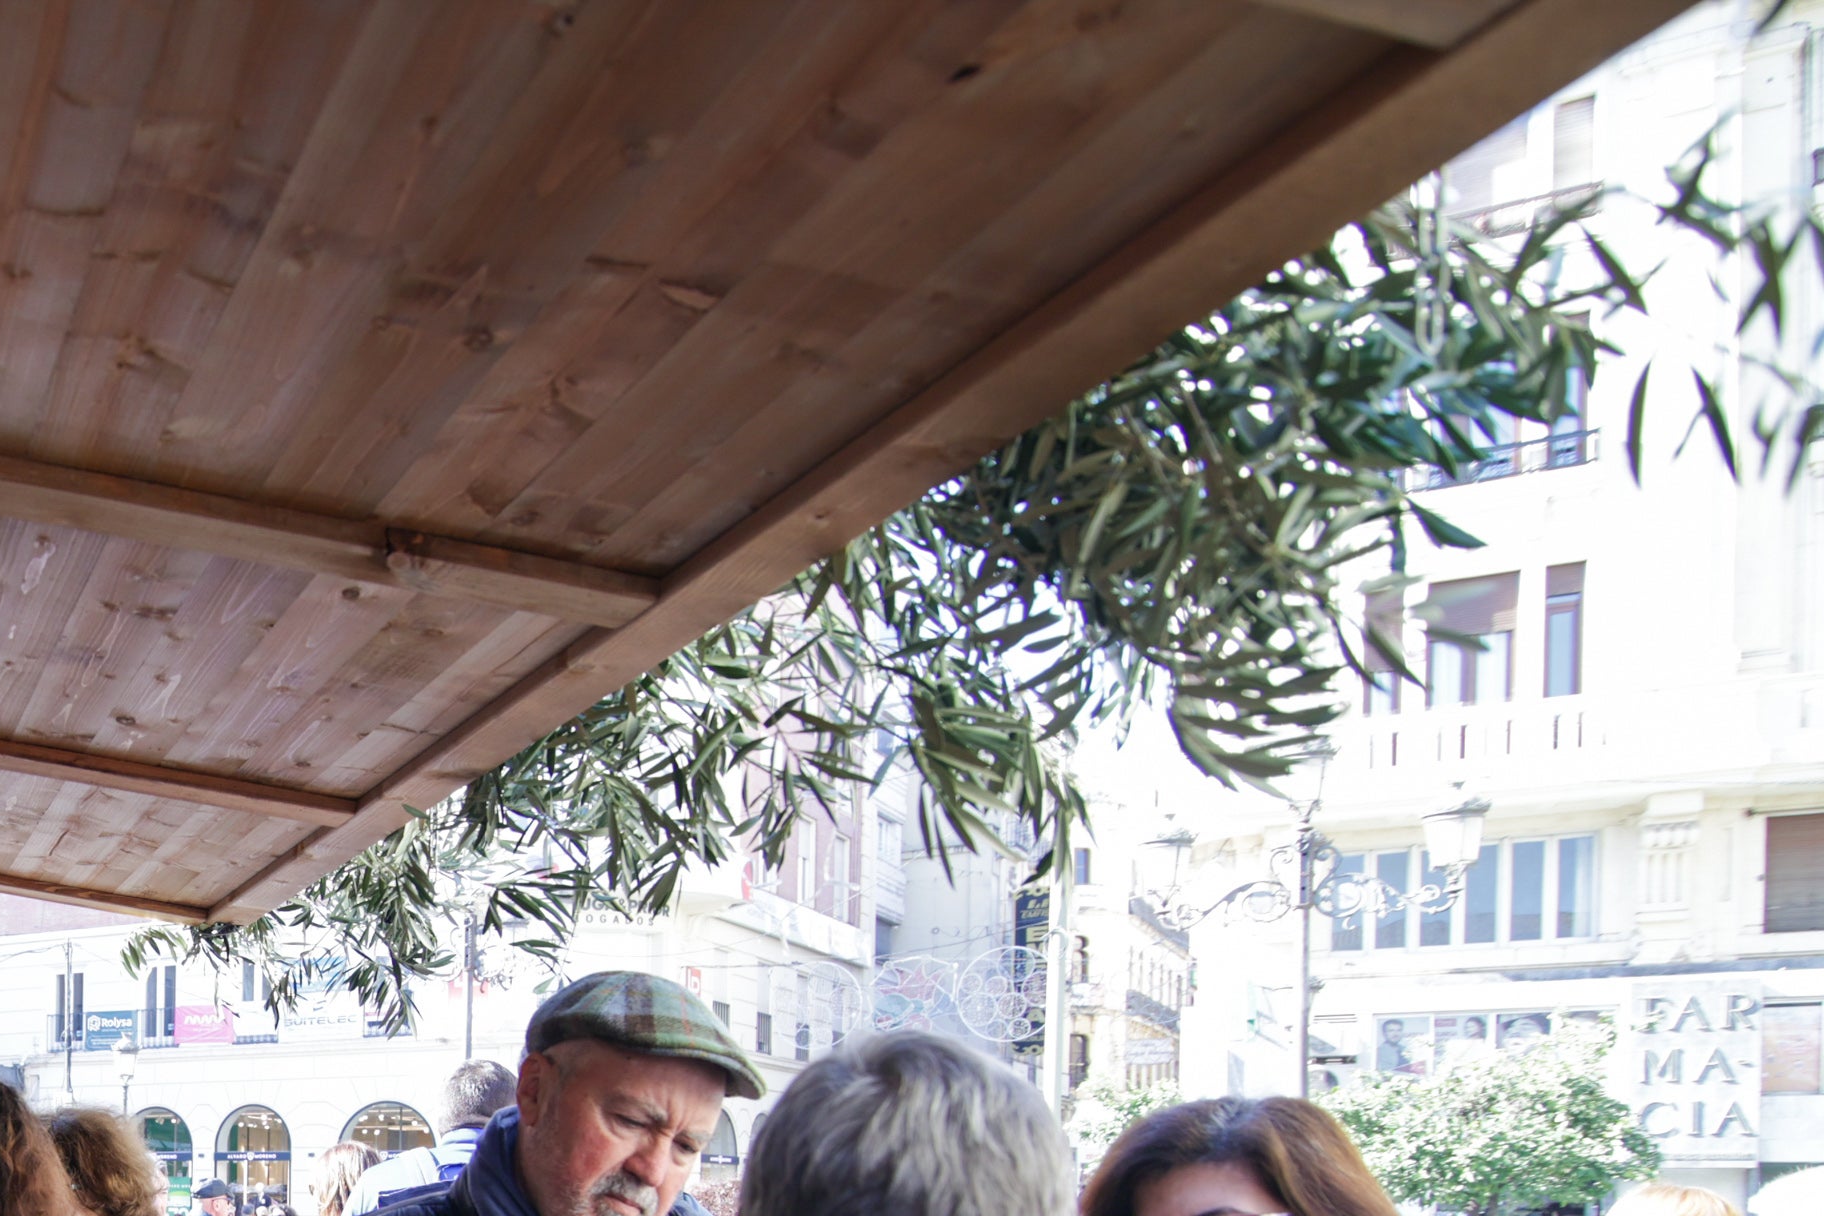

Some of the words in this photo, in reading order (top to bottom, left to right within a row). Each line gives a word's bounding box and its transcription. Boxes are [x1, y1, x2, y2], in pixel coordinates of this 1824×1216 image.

[101, 1016, 133, 1028] Rolysa
[1638, 994, 1762, 1034] FAR
[1638, 1100, 1760, 1139] CIA
